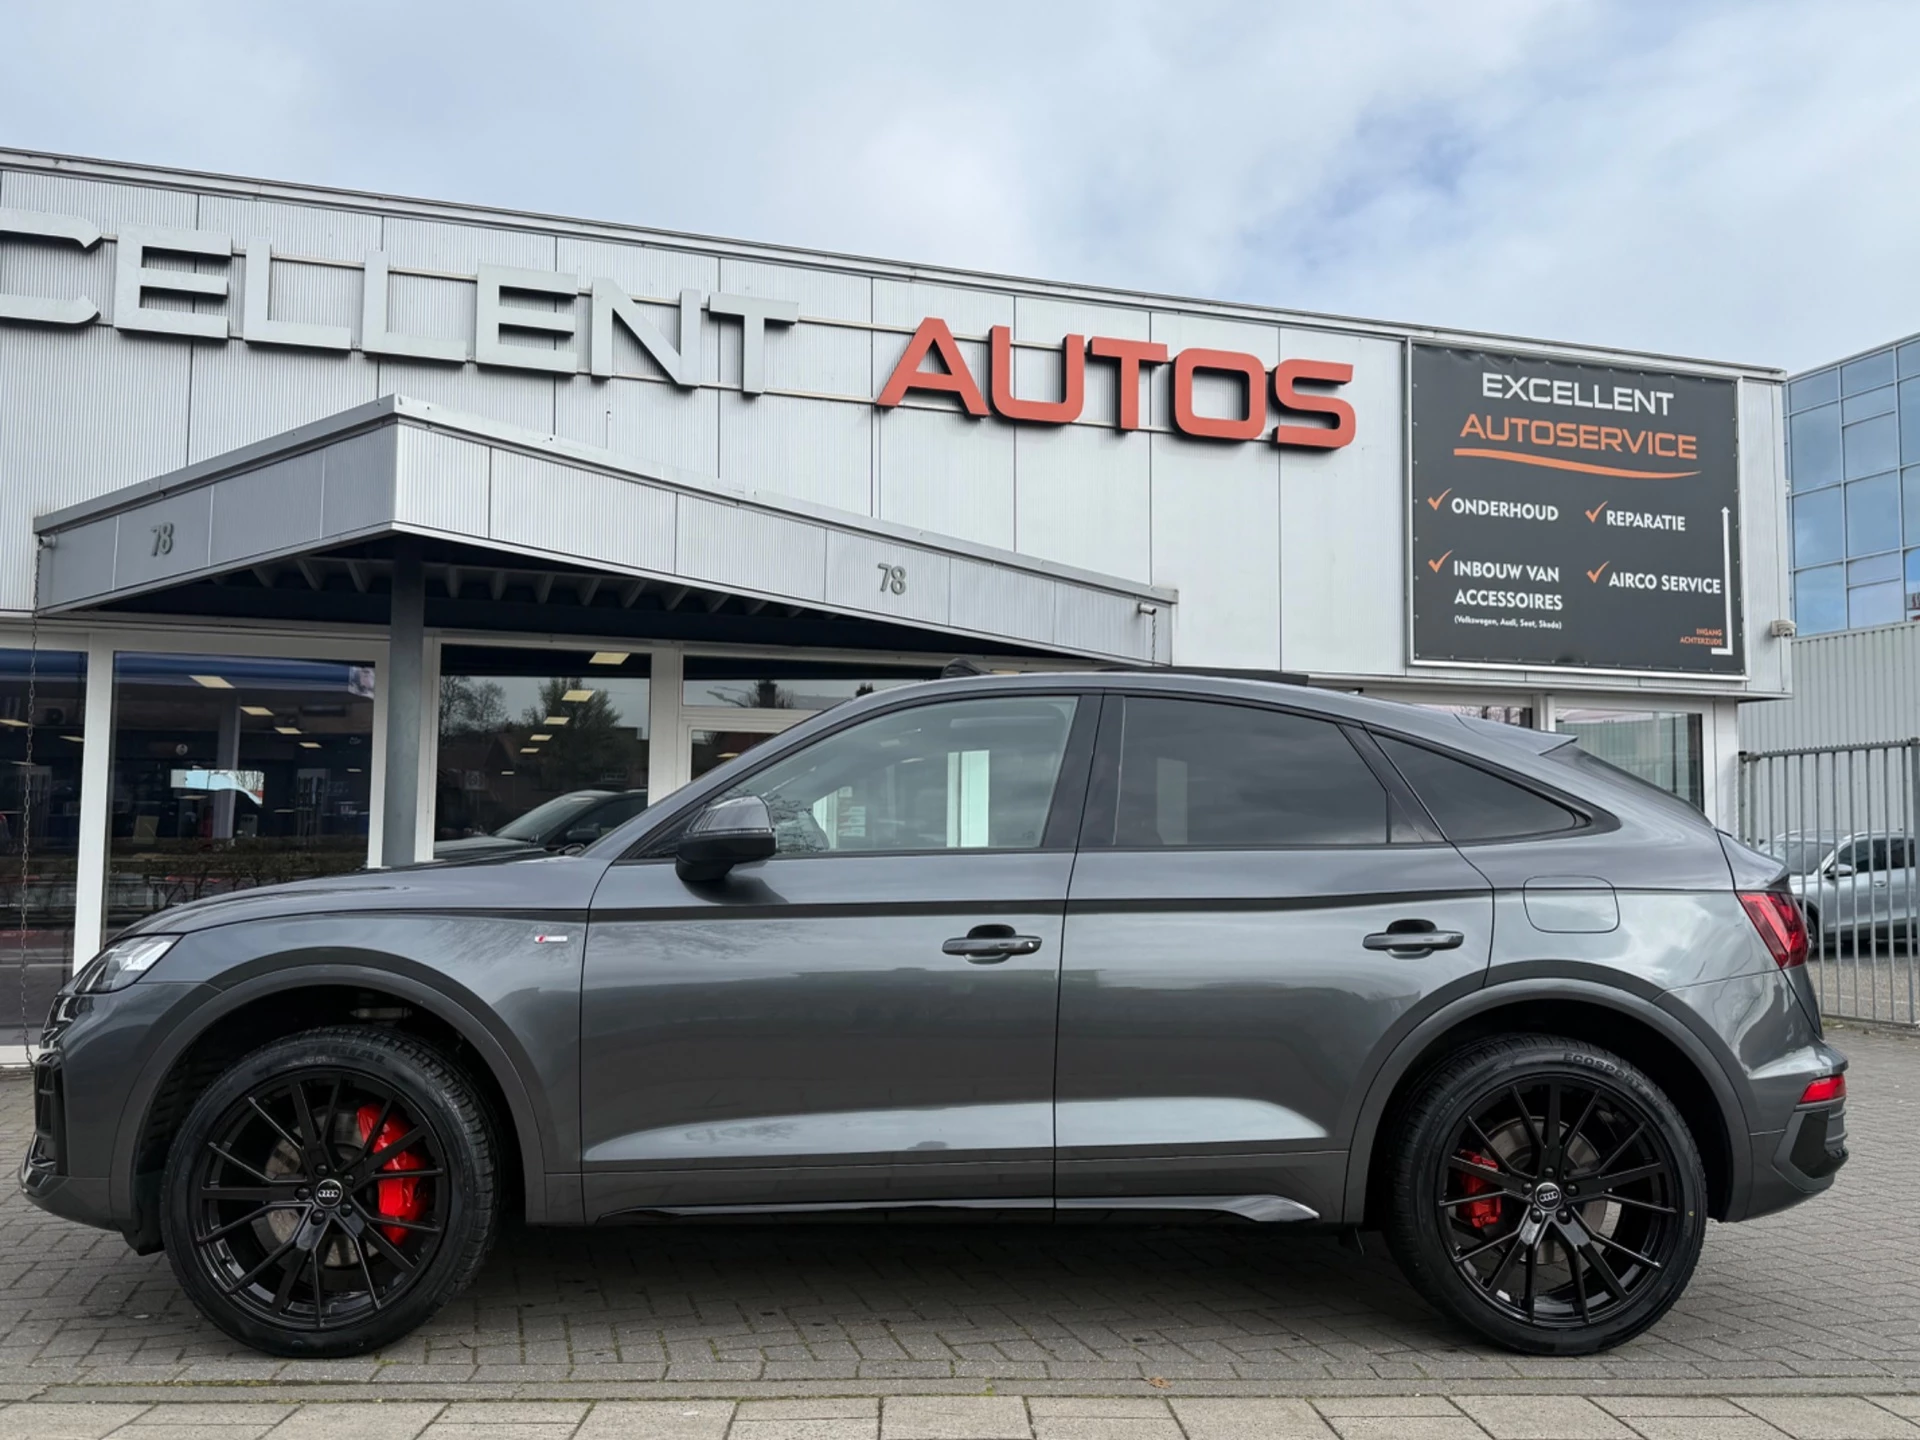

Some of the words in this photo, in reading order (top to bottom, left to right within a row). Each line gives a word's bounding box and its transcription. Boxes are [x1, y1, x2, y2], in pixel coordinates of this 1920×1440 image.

[876, 316, 1356, 448] AUTOS
[1482, 372, 1674, 416] EXCELLENT
[1460, 413, 1697, 459] AUTOSERVICE
[1451, 497, 1559, 521] ONDERHOUD
[1606, 510, 1686, 532] REPARATIE
[150, 522, 174, 557] 78
[877, 563, 906, 595] 78
[1453, 560, 1523, 580] INBOUW
[1526, 565, 1559, 583] VAN
[1608, 572, 1657, 590] AIRCO
[1661, 574, 1721, 594] SERVICE
[1454, 589, 1563, 611] ACCESSOIRES
[1563, 1053, 1644, 1089] ECOSPORT
